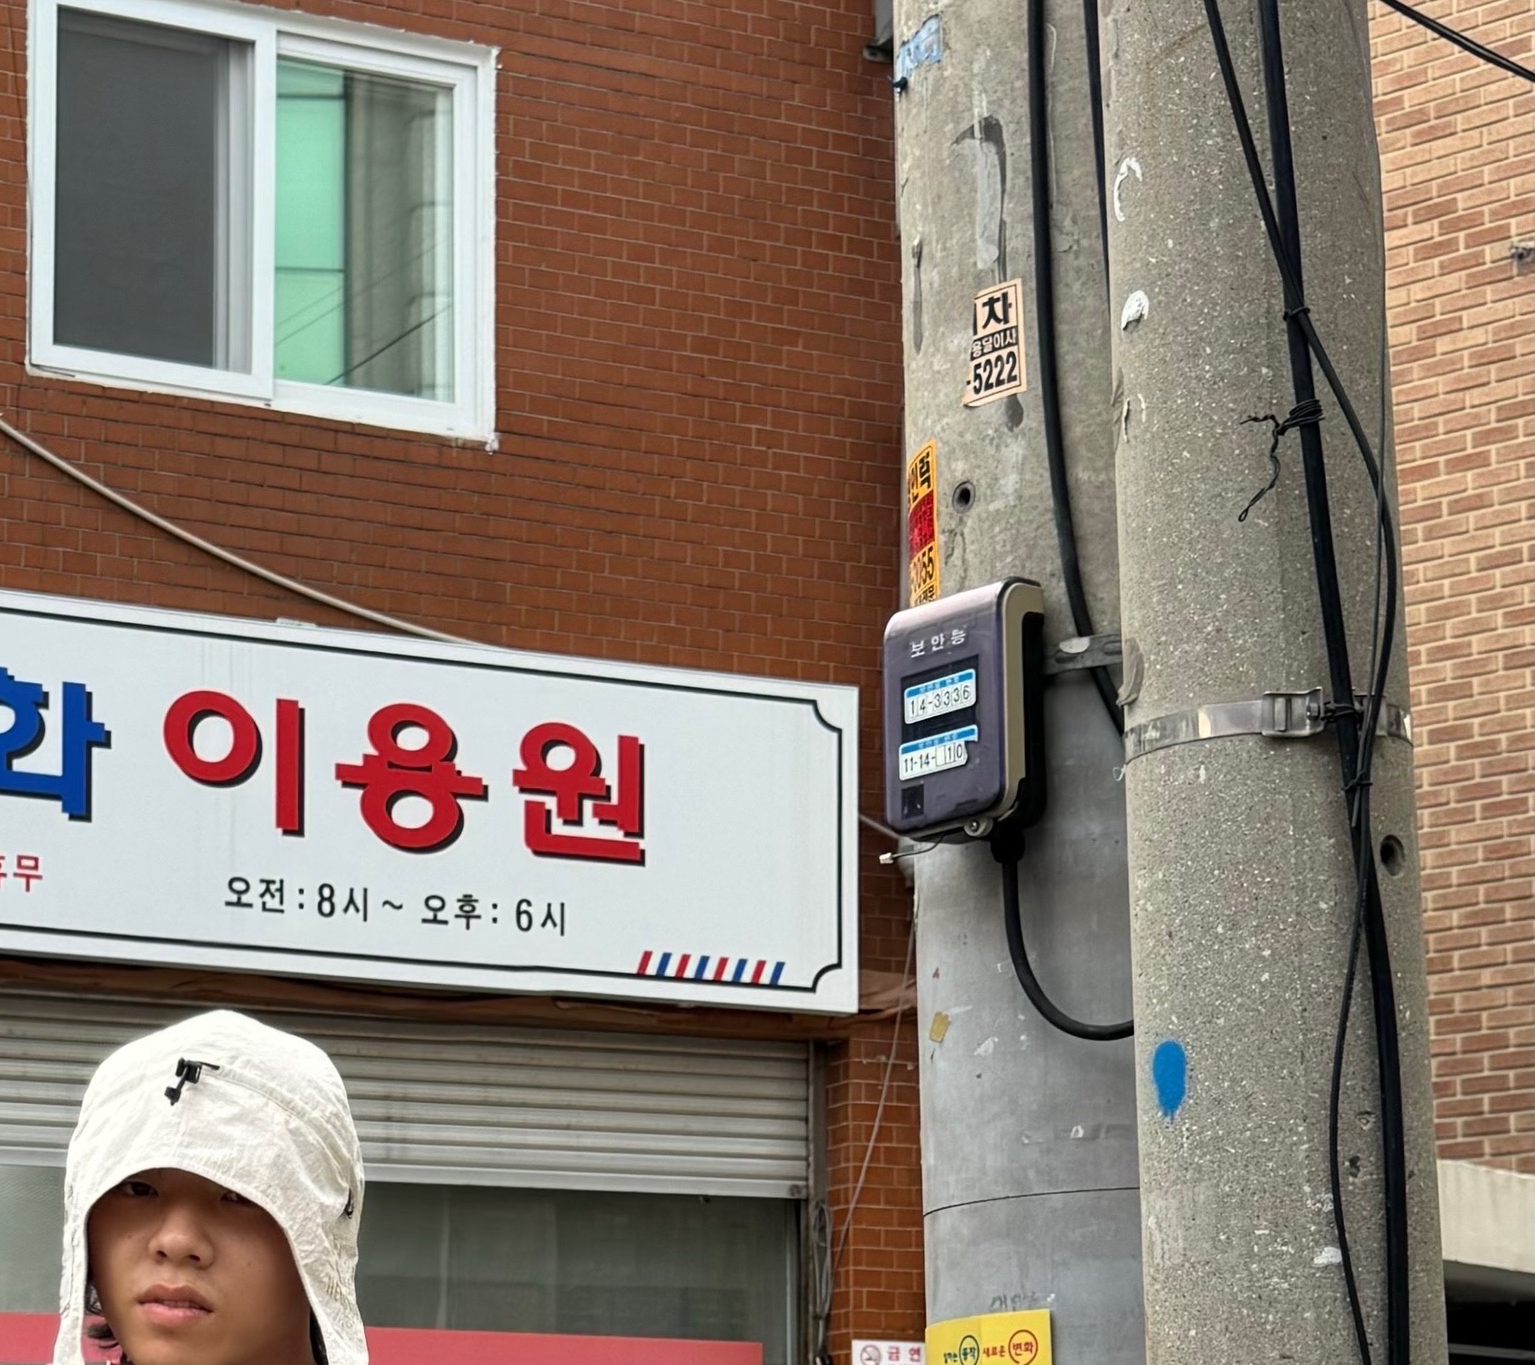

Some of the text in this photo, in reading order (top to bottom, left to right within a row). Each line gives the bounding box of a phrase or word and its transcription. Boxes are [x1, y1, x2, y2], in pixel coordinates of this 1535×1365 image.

[910, 684, 971, 716] 14-3336
[163, 690, 647, 866] 이용원
[983, 1343, 1007, 1358] 새로운
[1012, 1341, 1035, 1357] 변화
